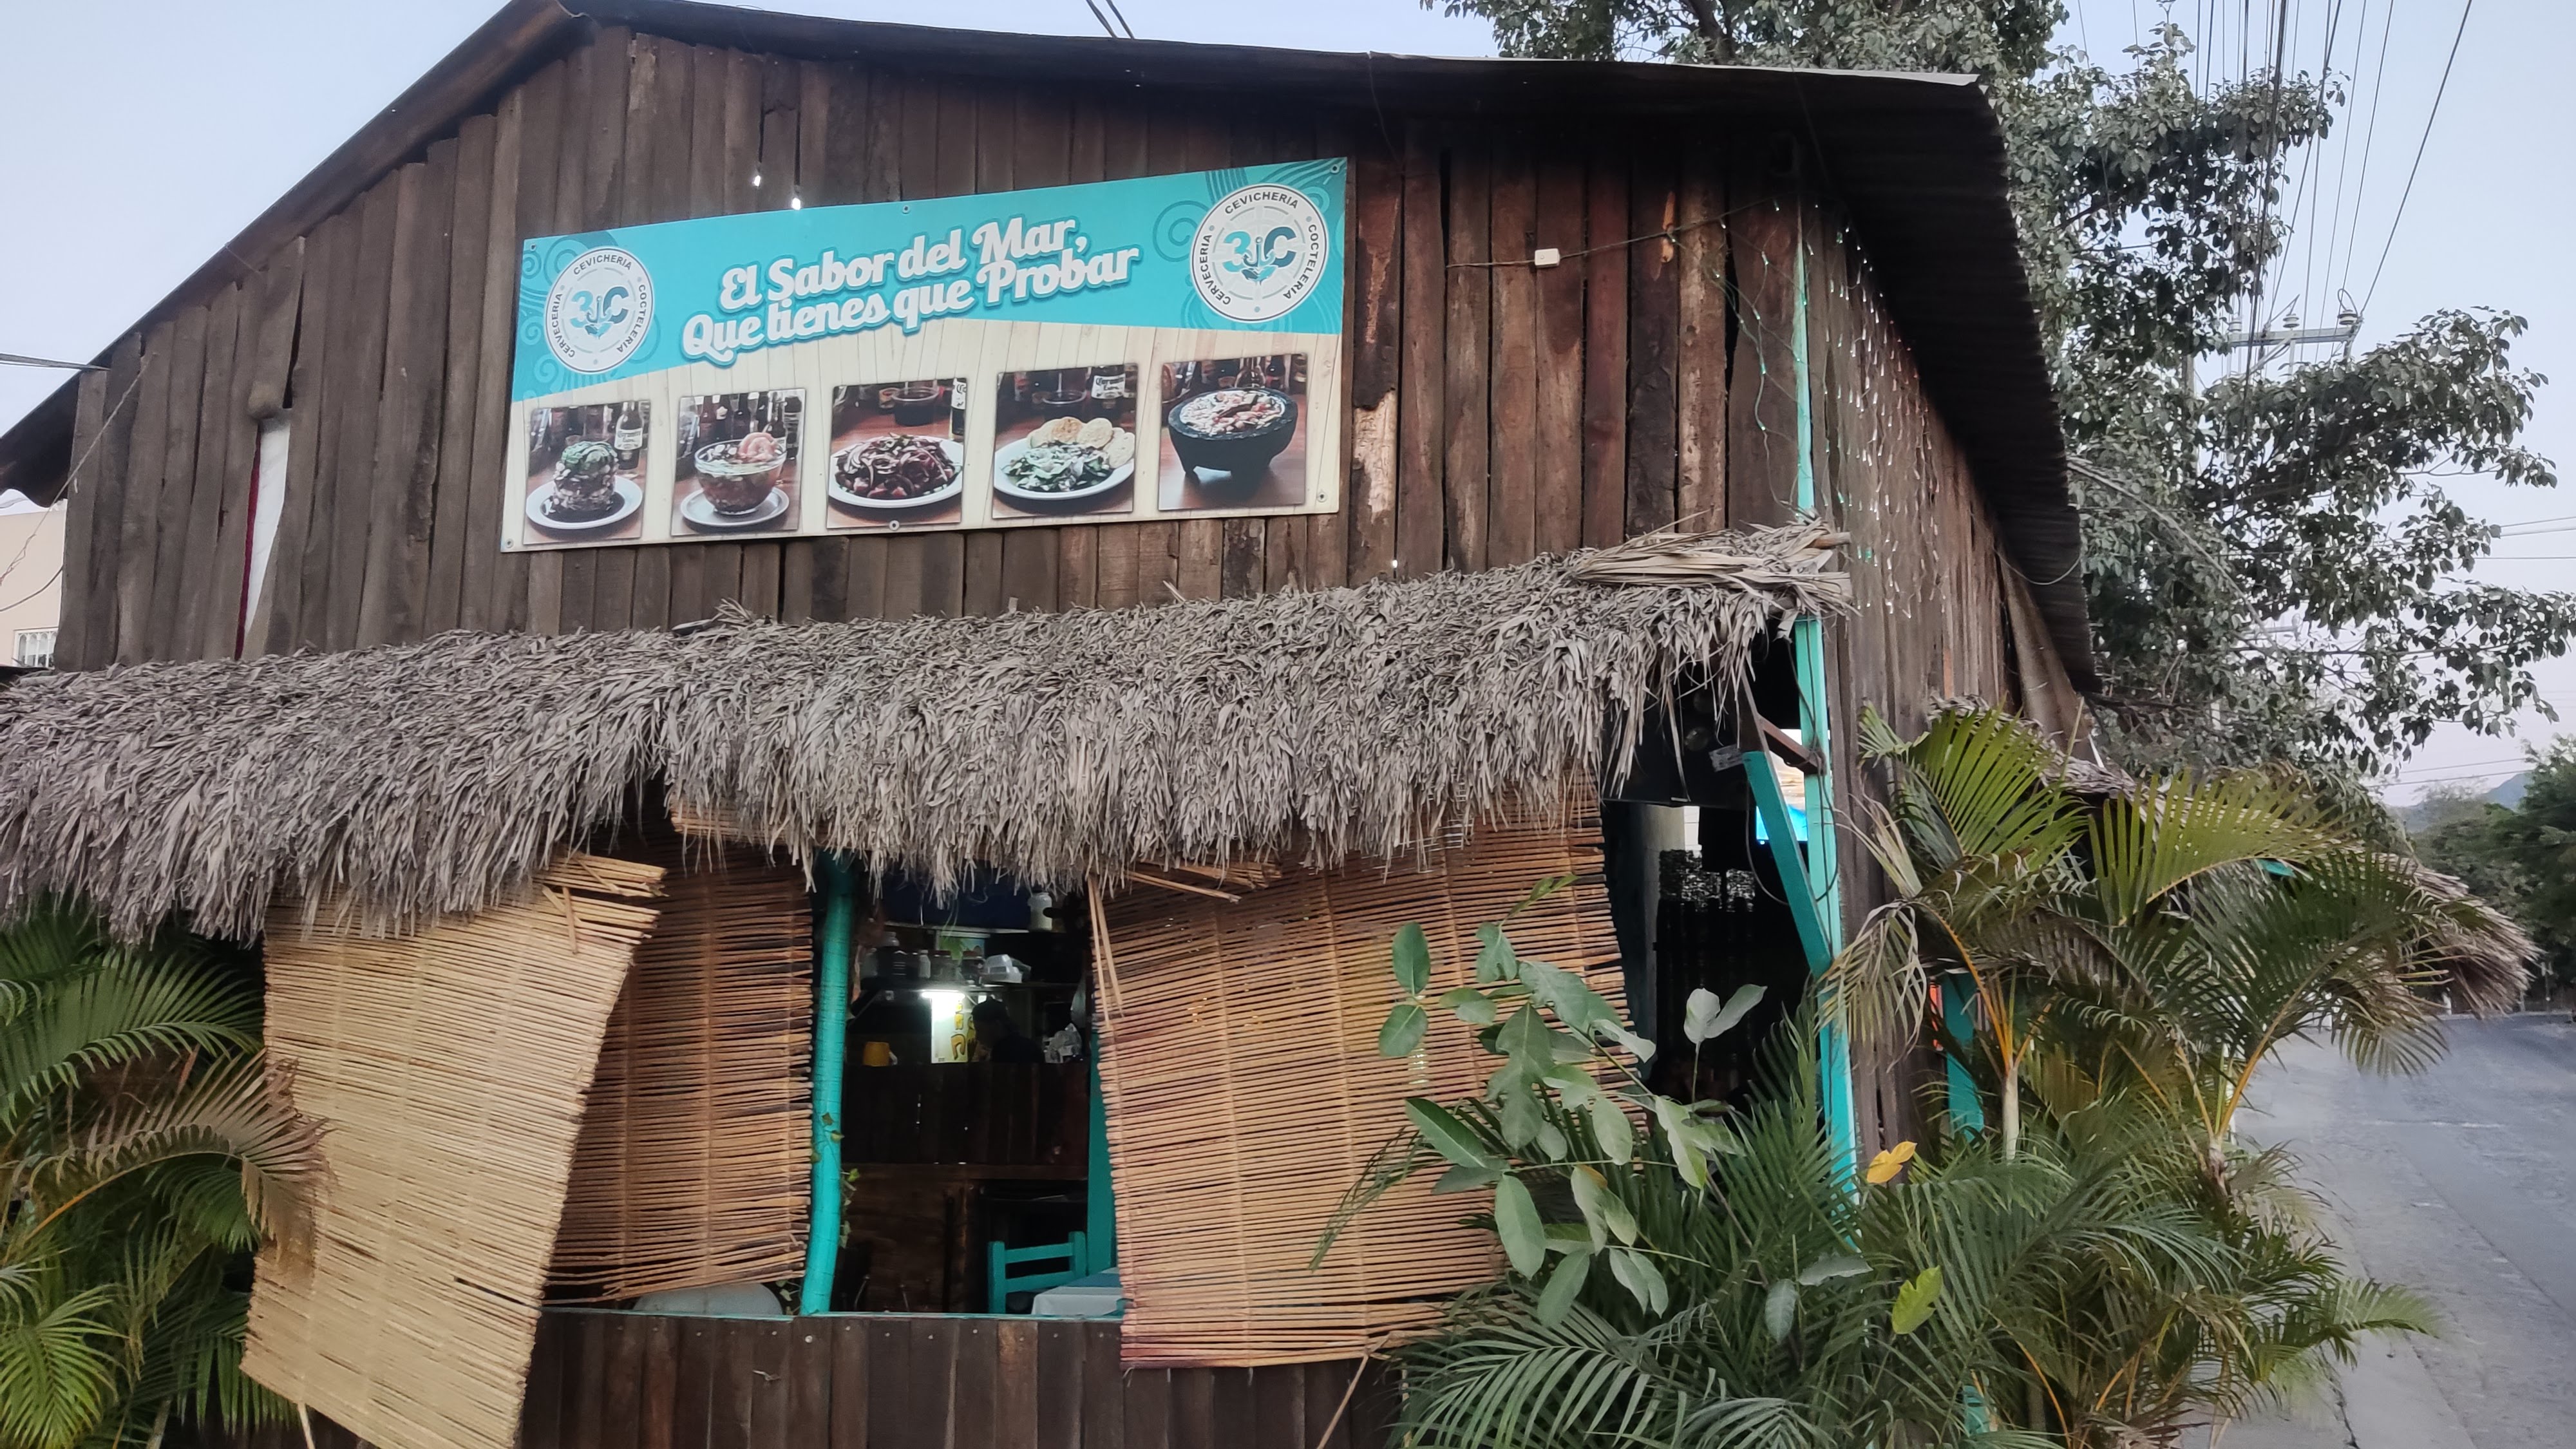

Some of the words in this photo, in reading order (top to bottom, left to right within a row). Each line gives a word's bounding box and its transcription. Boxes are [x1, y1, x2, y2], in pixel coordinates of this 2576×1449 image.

[1224, 191, 1299, 214] CEVICHERIA
[573, 254, 632, 275] CEVICHERIA
[719, 264, 764, 310] El
[767, 251, 895, 301] Sabor
[898, 228, 967, 279] del
[971, 216, 1088, 266] Mar,
[1198, 234, 1232, 306] CERVECERIA
[1282, 224, 1320, 299] COCTELERIA
[551, 292, 576, 358] CERVECERIA
[616, 284, 648, 353] COCTELERIA
[682, 314, 765, 363] Que
[766, 292, 891, 341] tienes
[893, 279, 975, 330] que
[976, 247, 1140, 303] Probar
